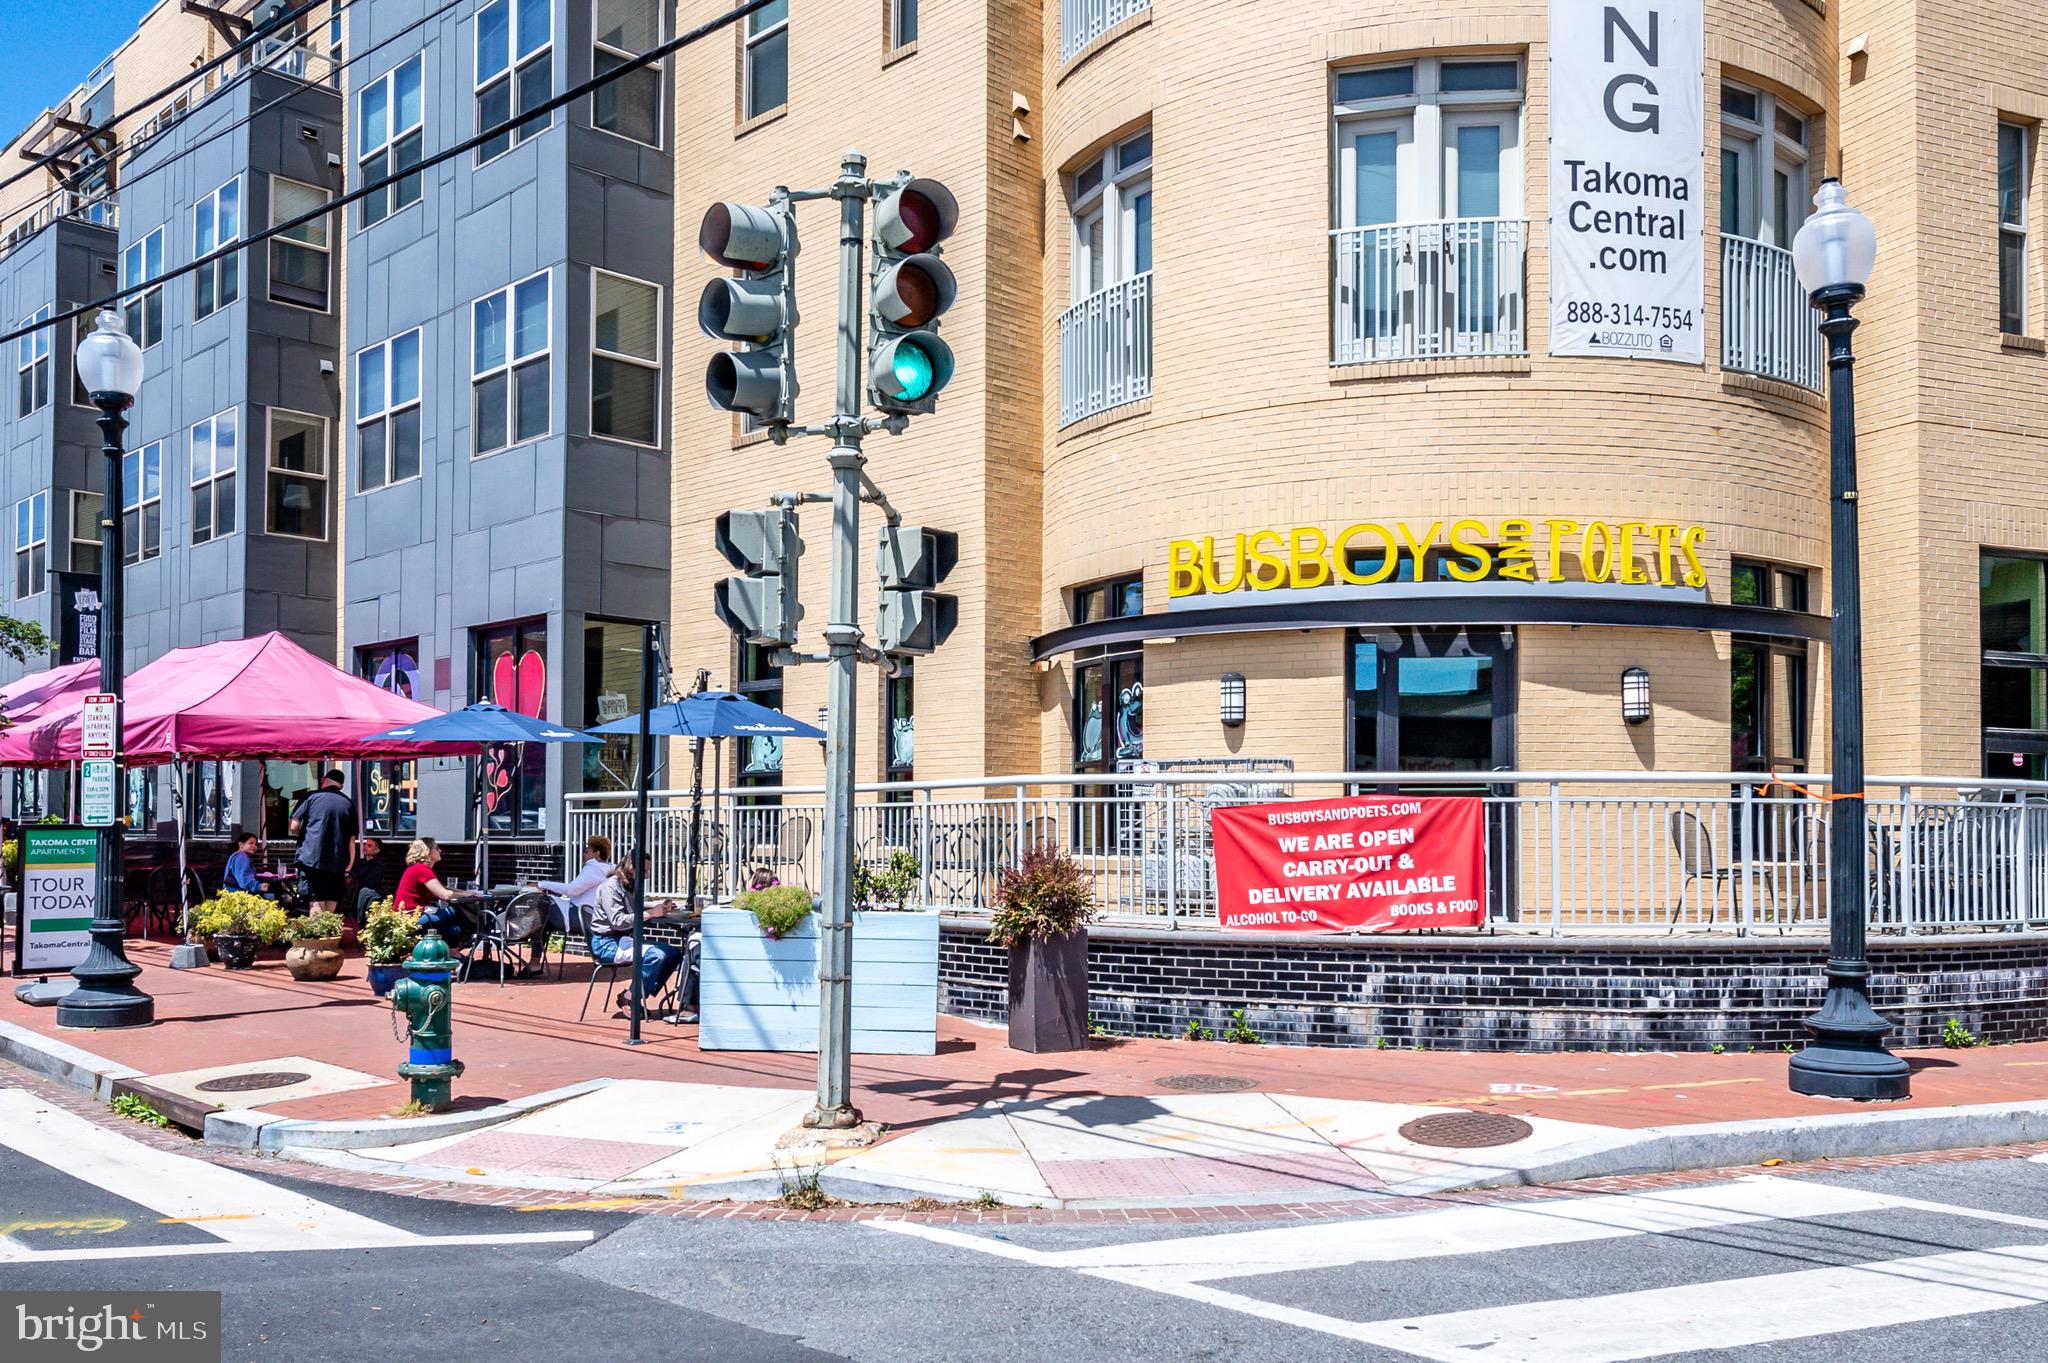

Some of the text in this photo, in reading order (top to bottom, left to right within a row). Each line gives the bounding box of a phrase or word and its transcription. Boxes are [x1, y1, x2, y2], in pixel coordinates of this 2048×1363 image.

[1563, 159, 1689, 202] Takoma
[1568, 200, 1685, 240] Central
[1589, 245, 1667, 274] .com
[1567, 301, 1694, 332] 888-314-7554
[1601, 331, 1653, 348] BOZZUTO
[1168, 519, 1708, 598] BUSBOYS AND POETS
[79, 614, 97, 623] FOOD
[79, 627, 97, 635] FILM
[79, 647, 97, 656] BAR
[87, 714, 110, 722] STANDING
[85, 765, 90, 776] 2
[370, 768, 390, 814] Stay
[1268, 802, 1422, 826] BUSBOYSANDPOETS.COM
[30, 848, 86, 856] APARTMENTS
[1278, 827, 1415, 854] WE ARE OPEN
[1282, 853, 1415, 878] CARRY-OUT &
[30, 877, 84, 892] TOUR
[1248, 875, 1456, 905] DELIVERY AVAILABLE
[29, 895, 96, 910] TODAY
[1226, 899, 1479, 927] ALCOHOL TO-GO BOOKS & FOOD
